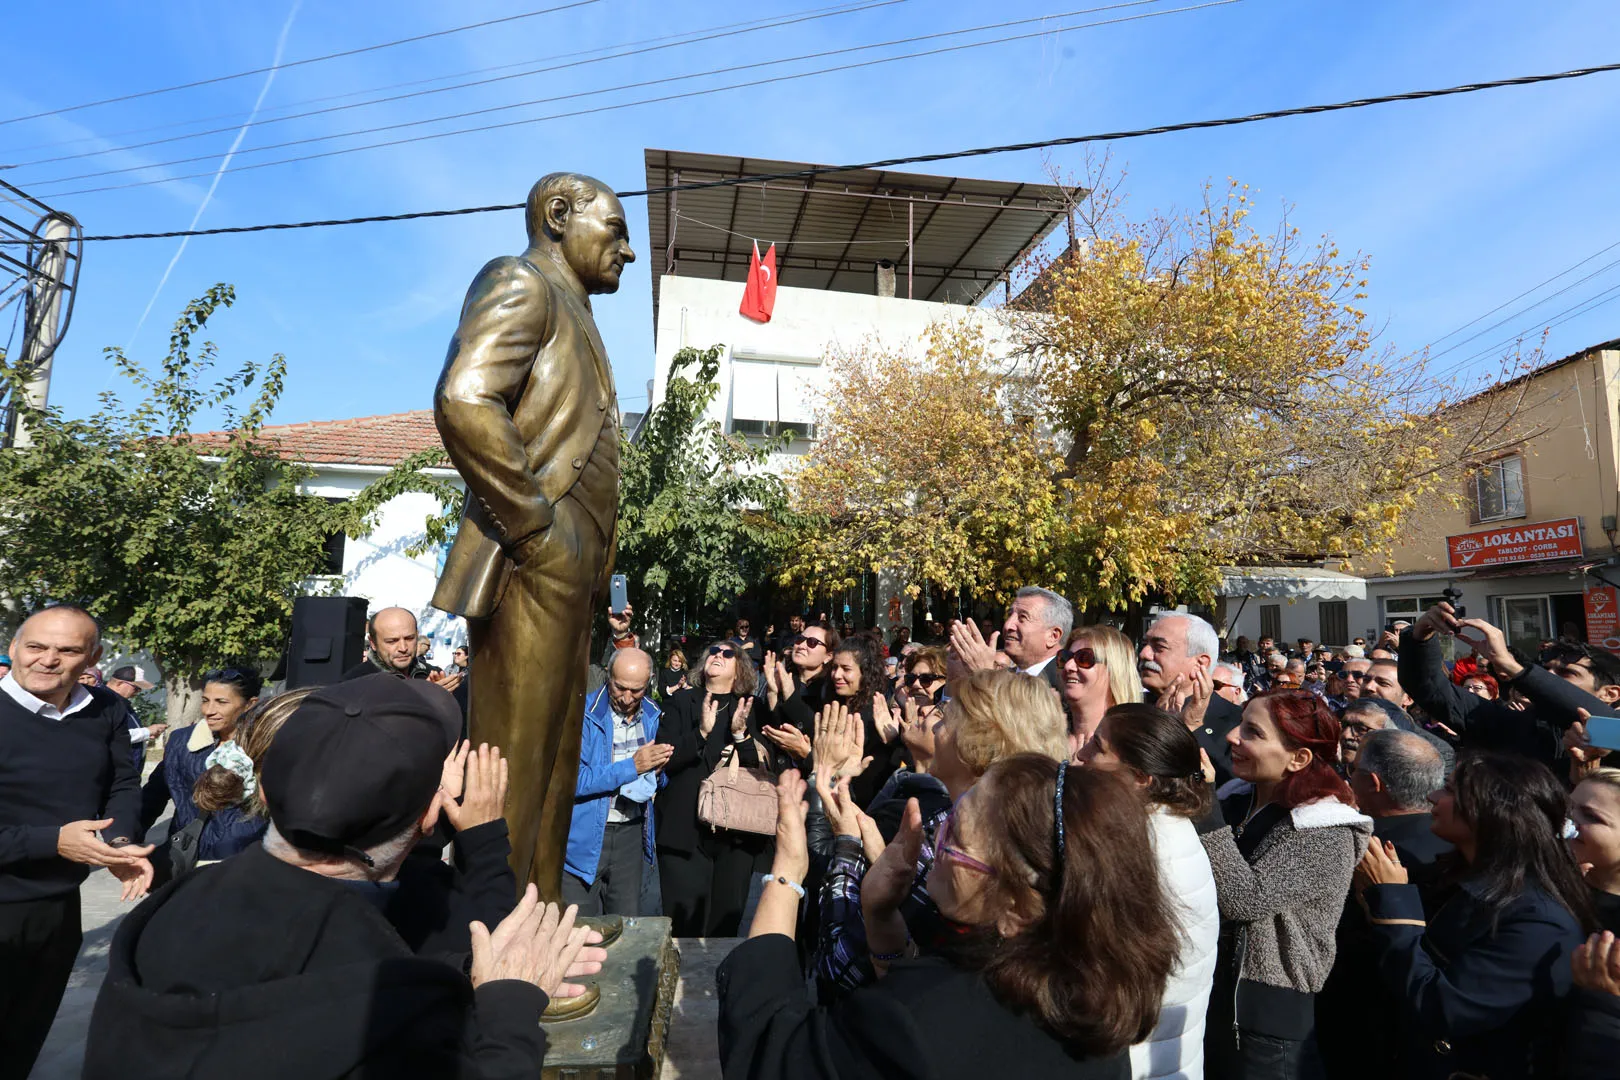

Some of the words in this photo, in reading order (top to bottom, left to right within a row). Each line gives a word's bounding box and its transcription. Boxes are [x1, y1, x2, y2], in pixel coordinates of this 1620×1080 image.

[1483, 525, 1573, 547] LOKANTASI
[1498, 546, 1527, 554] TABLDOT
[1533, 543, 1557, 551] ÇORBA
